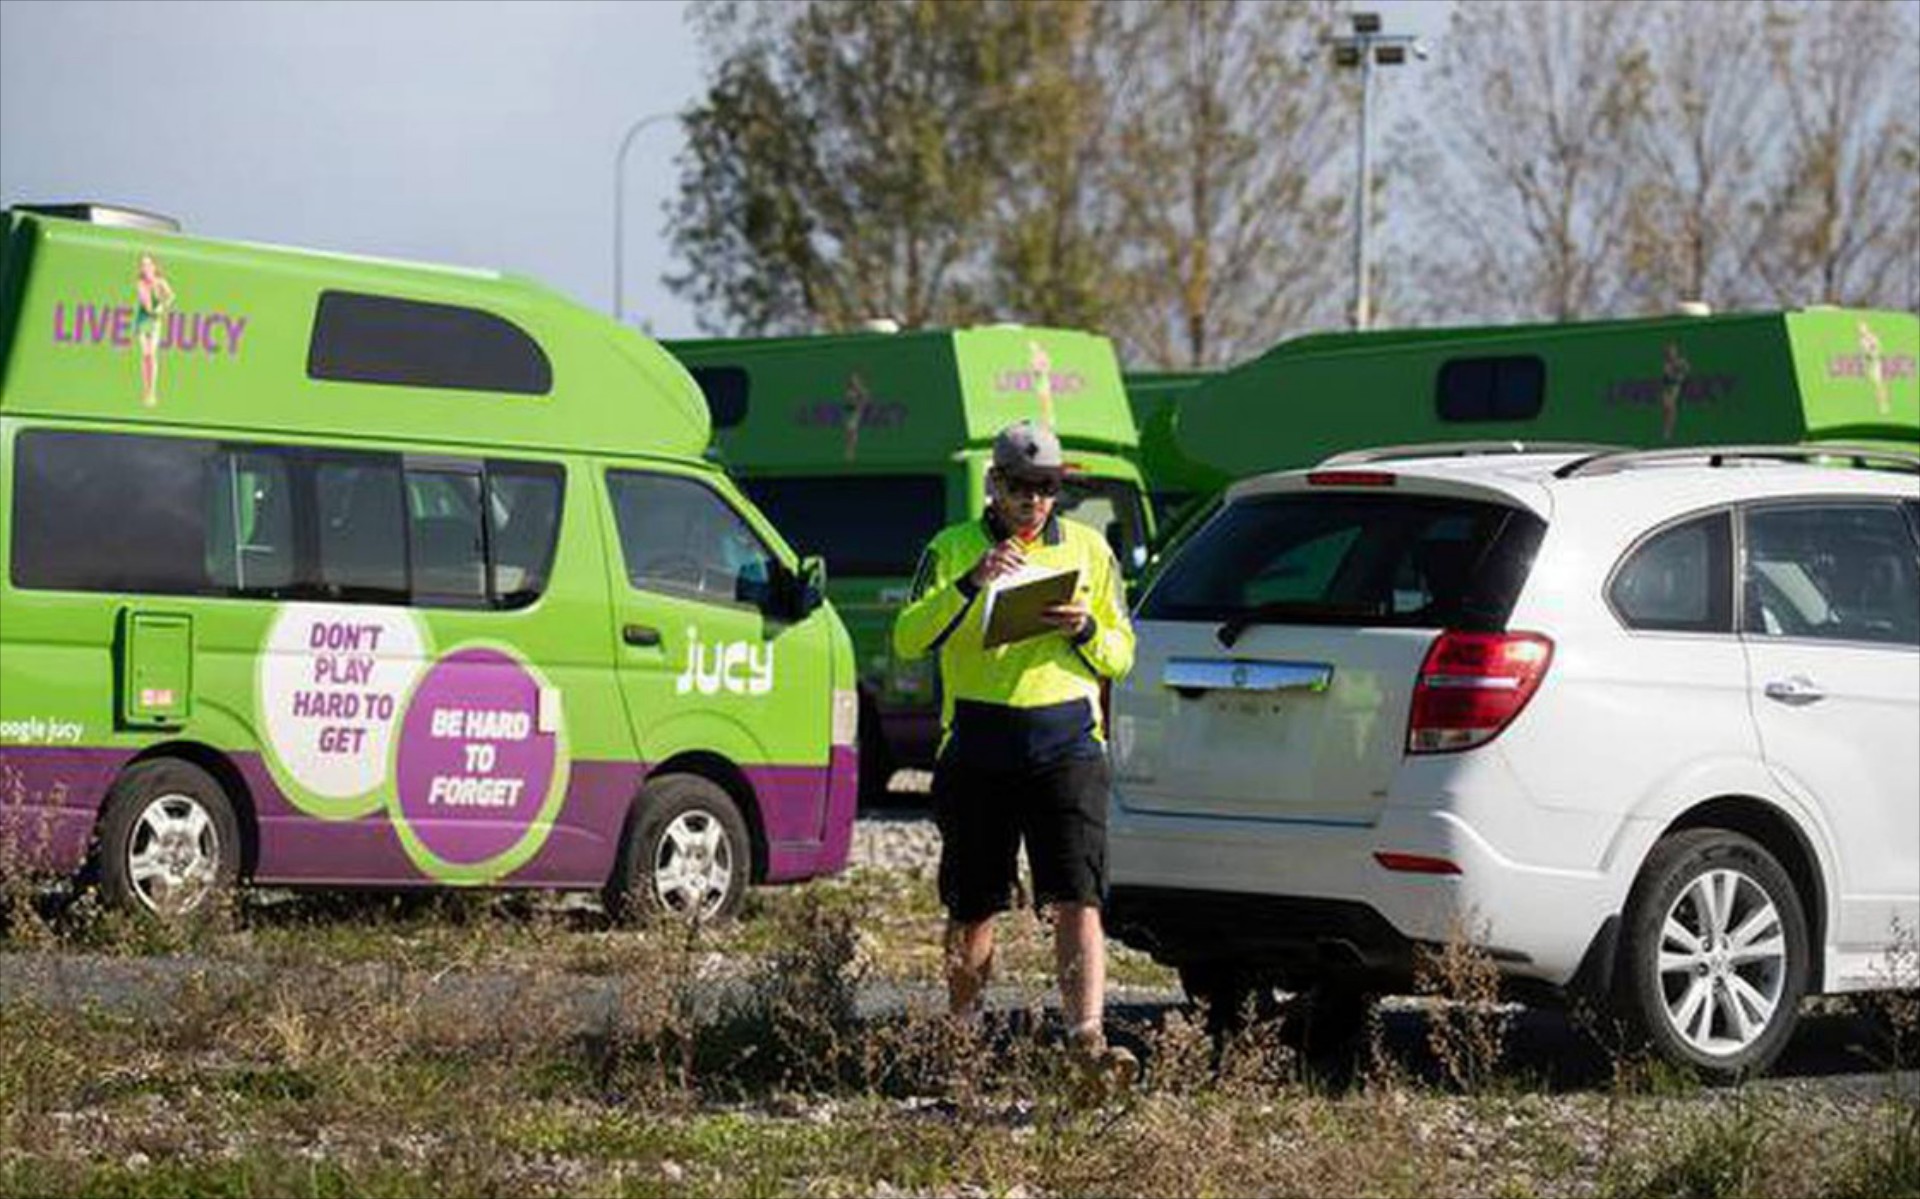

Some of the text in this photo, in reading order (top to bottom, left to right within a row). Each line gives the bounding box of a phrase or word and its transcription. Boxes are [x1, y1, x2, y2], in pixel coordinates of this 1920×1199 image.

[53, 302, 247, 354] LIVE JUCY
[310, 622, 384, 650] DON'T
[315, 656, 374, 684] PLAY
[677, 627, 774, 694] jucy
[293, 692, 394, 720] HARD TO
[0, 715, 83, 743] oogle jucy
[432, 708, 530, 740] BE HARD
[319, 727, 367, 753] GET
[465, 743, 496, 772] TO
[428, 776, 524, 806] FORGET
